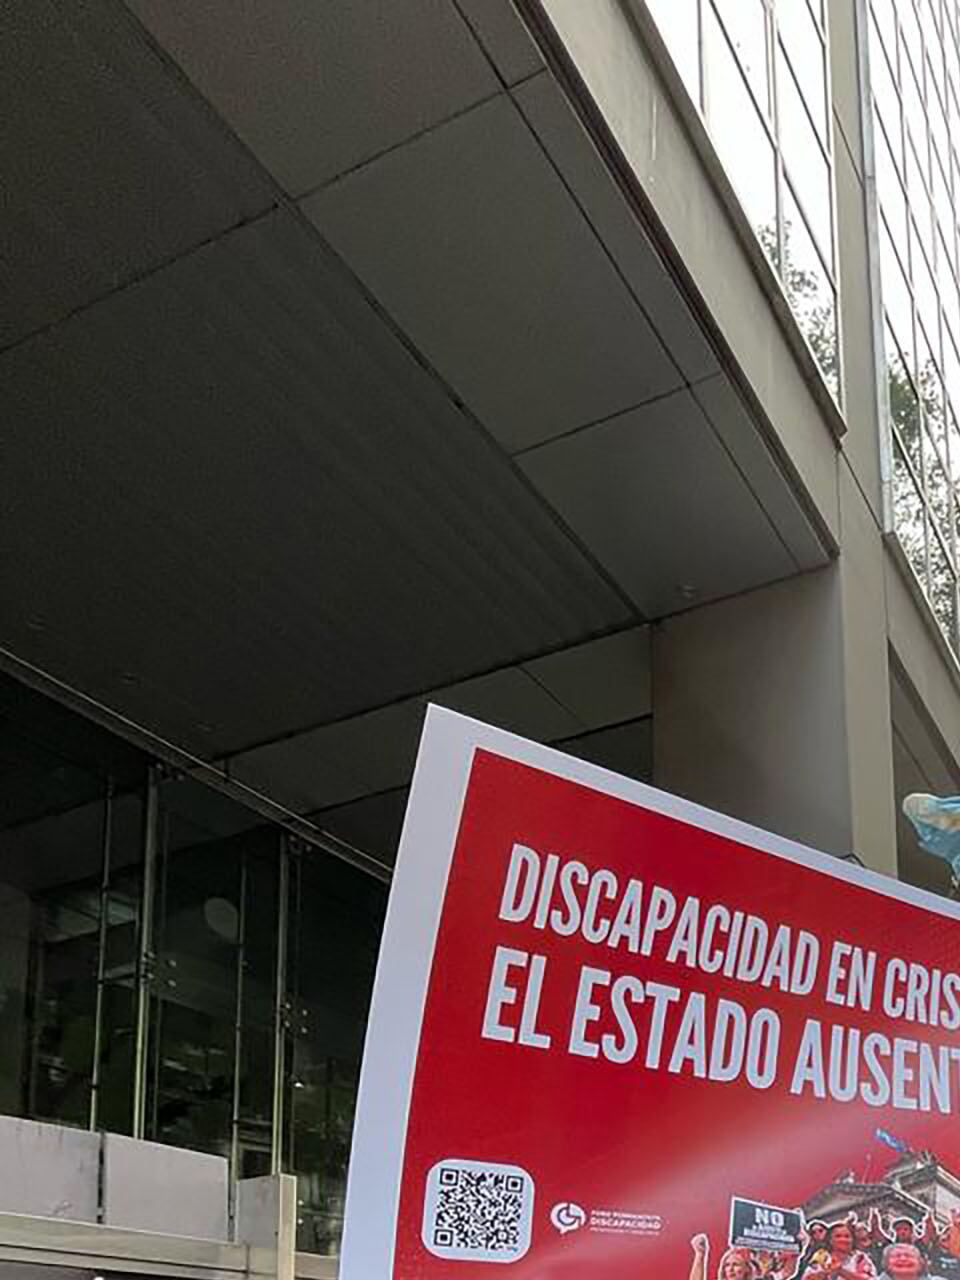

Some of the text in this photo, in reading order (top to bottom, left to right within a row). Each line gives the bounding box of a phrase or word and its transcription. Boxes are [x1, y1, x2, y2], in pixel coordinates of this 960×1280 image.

[499, 843, 820, 996] DISCAPACIDAD
[826, 941, 876, 1011] EN
[482, 946, 551, 1049] EL
[568, 966, 780, 1089] ESTADO
[755, 1208, 784, 1226] NO
